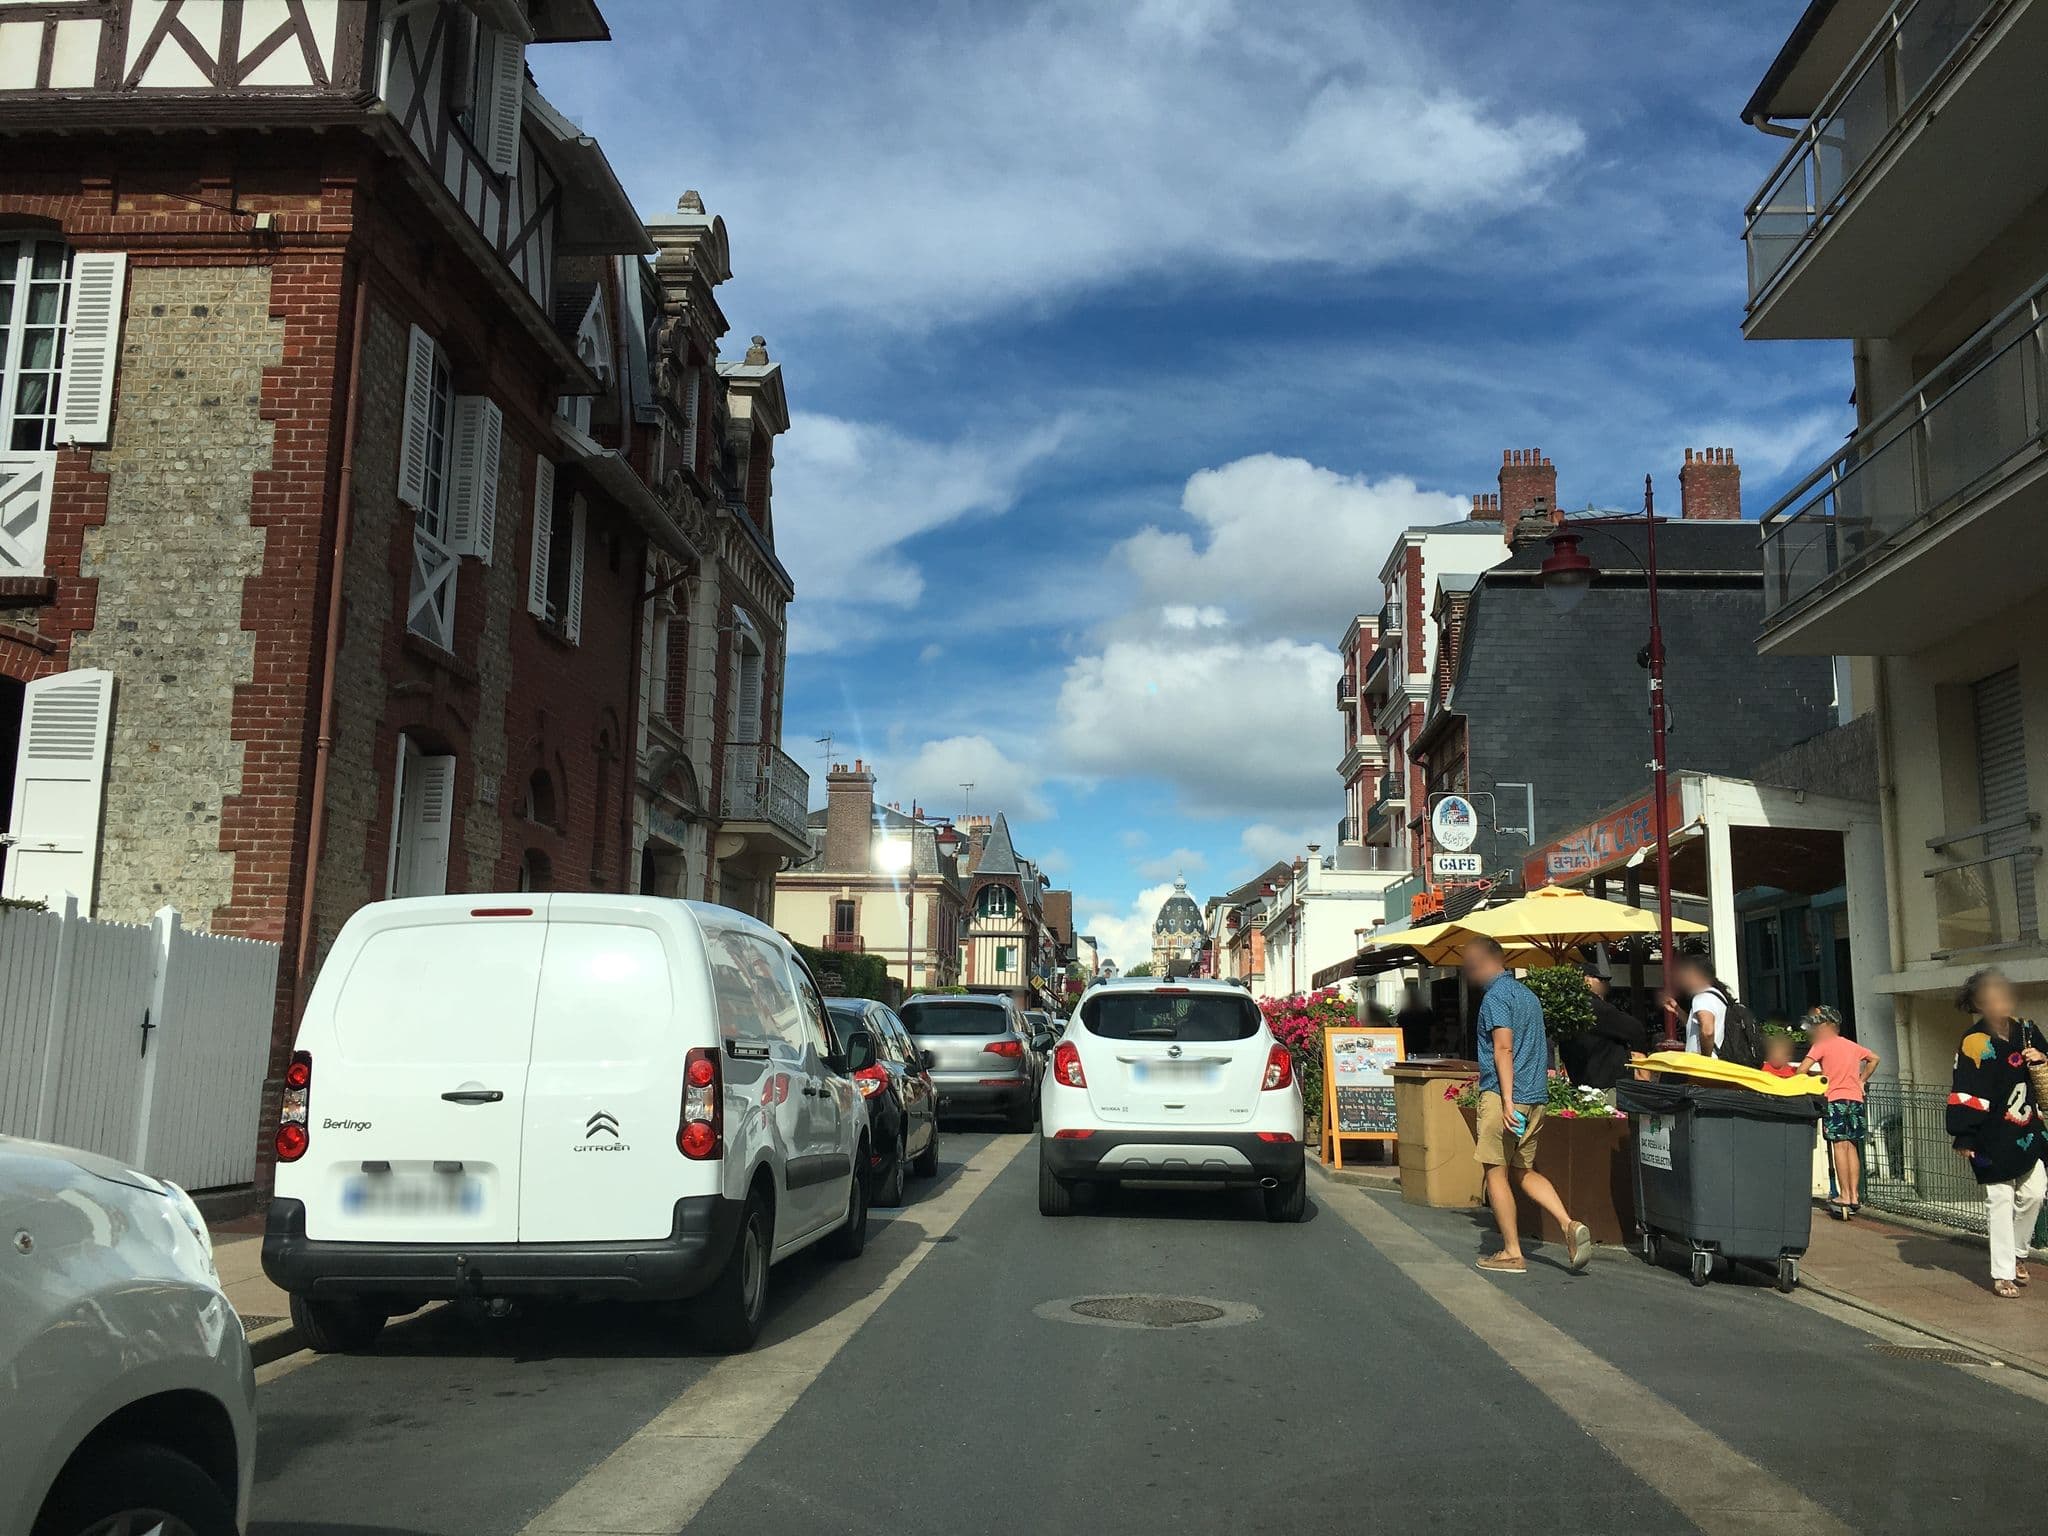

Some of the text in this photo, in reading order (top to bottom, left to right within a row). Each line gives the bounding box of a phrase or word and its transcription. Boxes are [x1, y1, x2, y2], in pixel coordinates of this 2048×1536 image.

[1613, 806, 1653, 853] CAFE
[1439, 858, 1476, 871] CAFE
[323, 1118, 372, 1131] Berlingo
[573, 1142, 631, 1152] CITROËN
